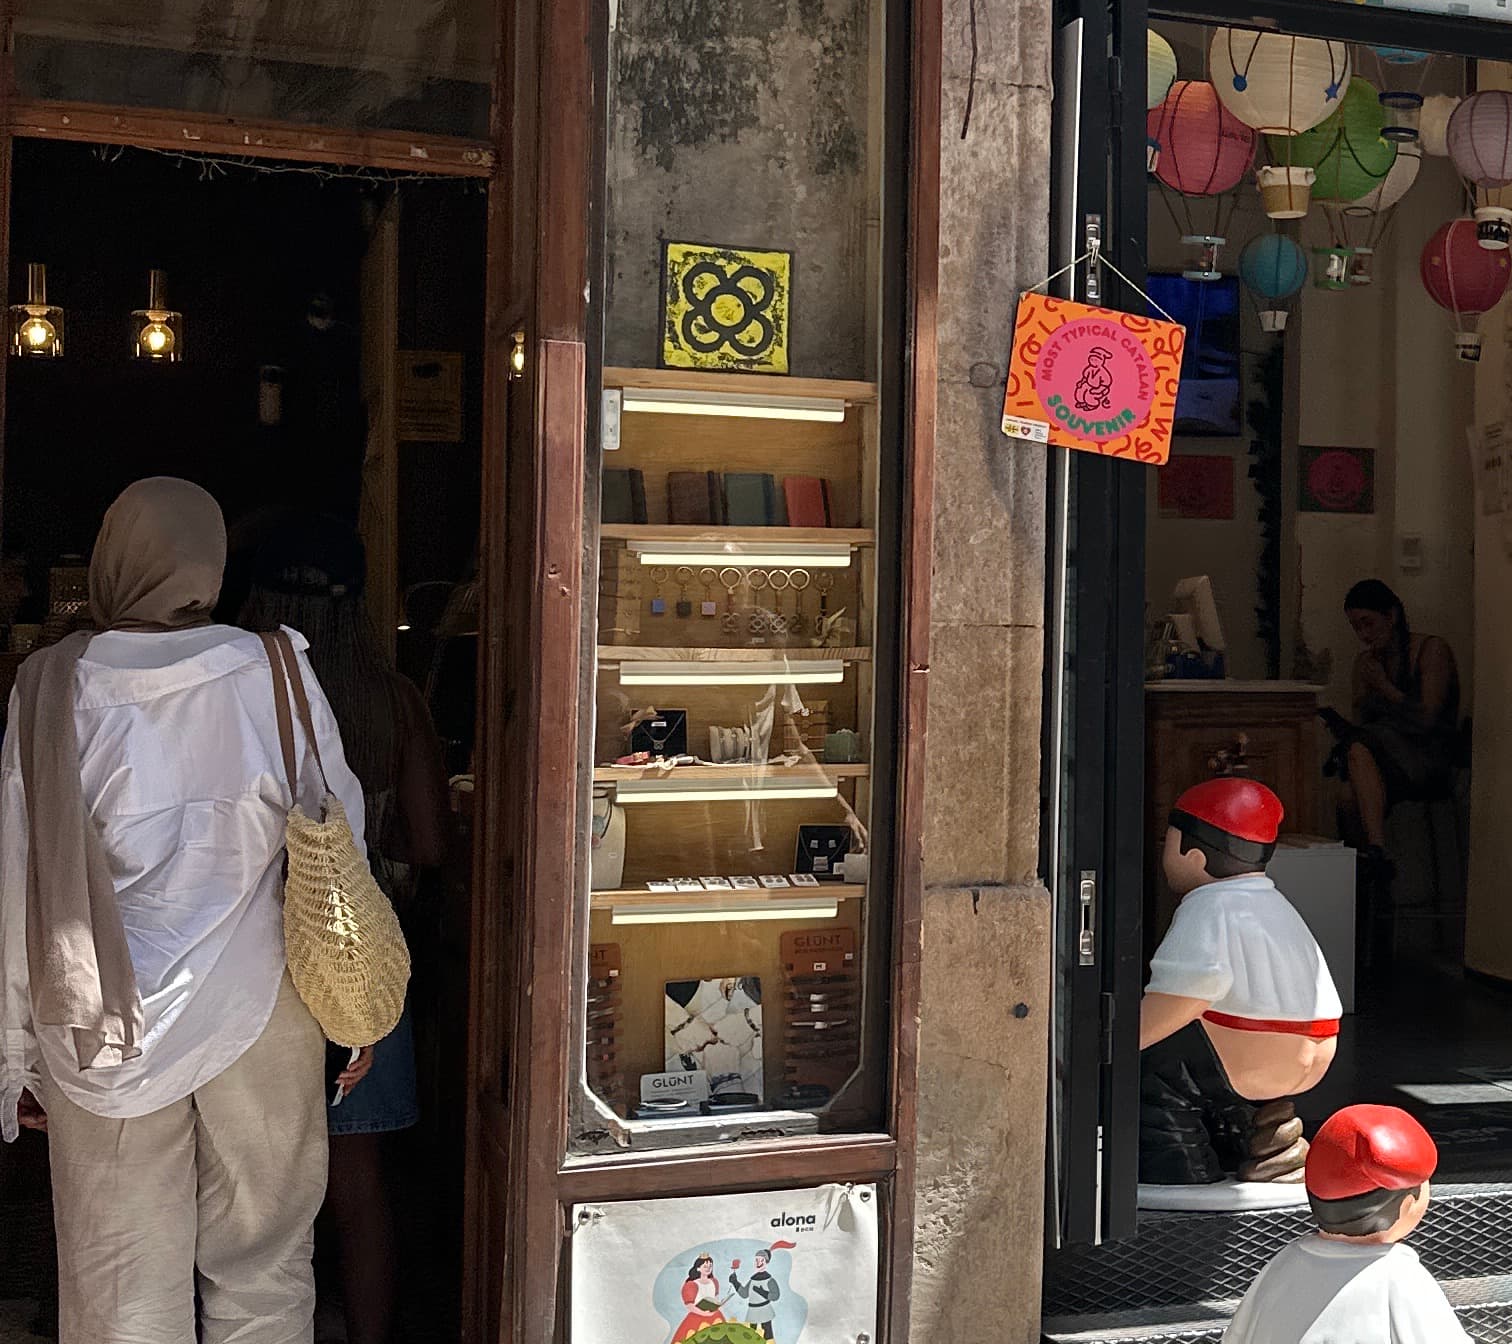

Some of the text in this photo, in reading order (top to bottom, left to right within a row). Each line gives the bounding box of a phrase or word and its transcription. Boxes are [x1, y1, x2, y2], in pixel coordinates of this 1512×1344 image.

[1041, 325, 1150, 401] MOST TYPICAL CATALAN
[1047, 394, 1137, 436] SOUVENIR
[770, 1212, 815, 1227] alona
